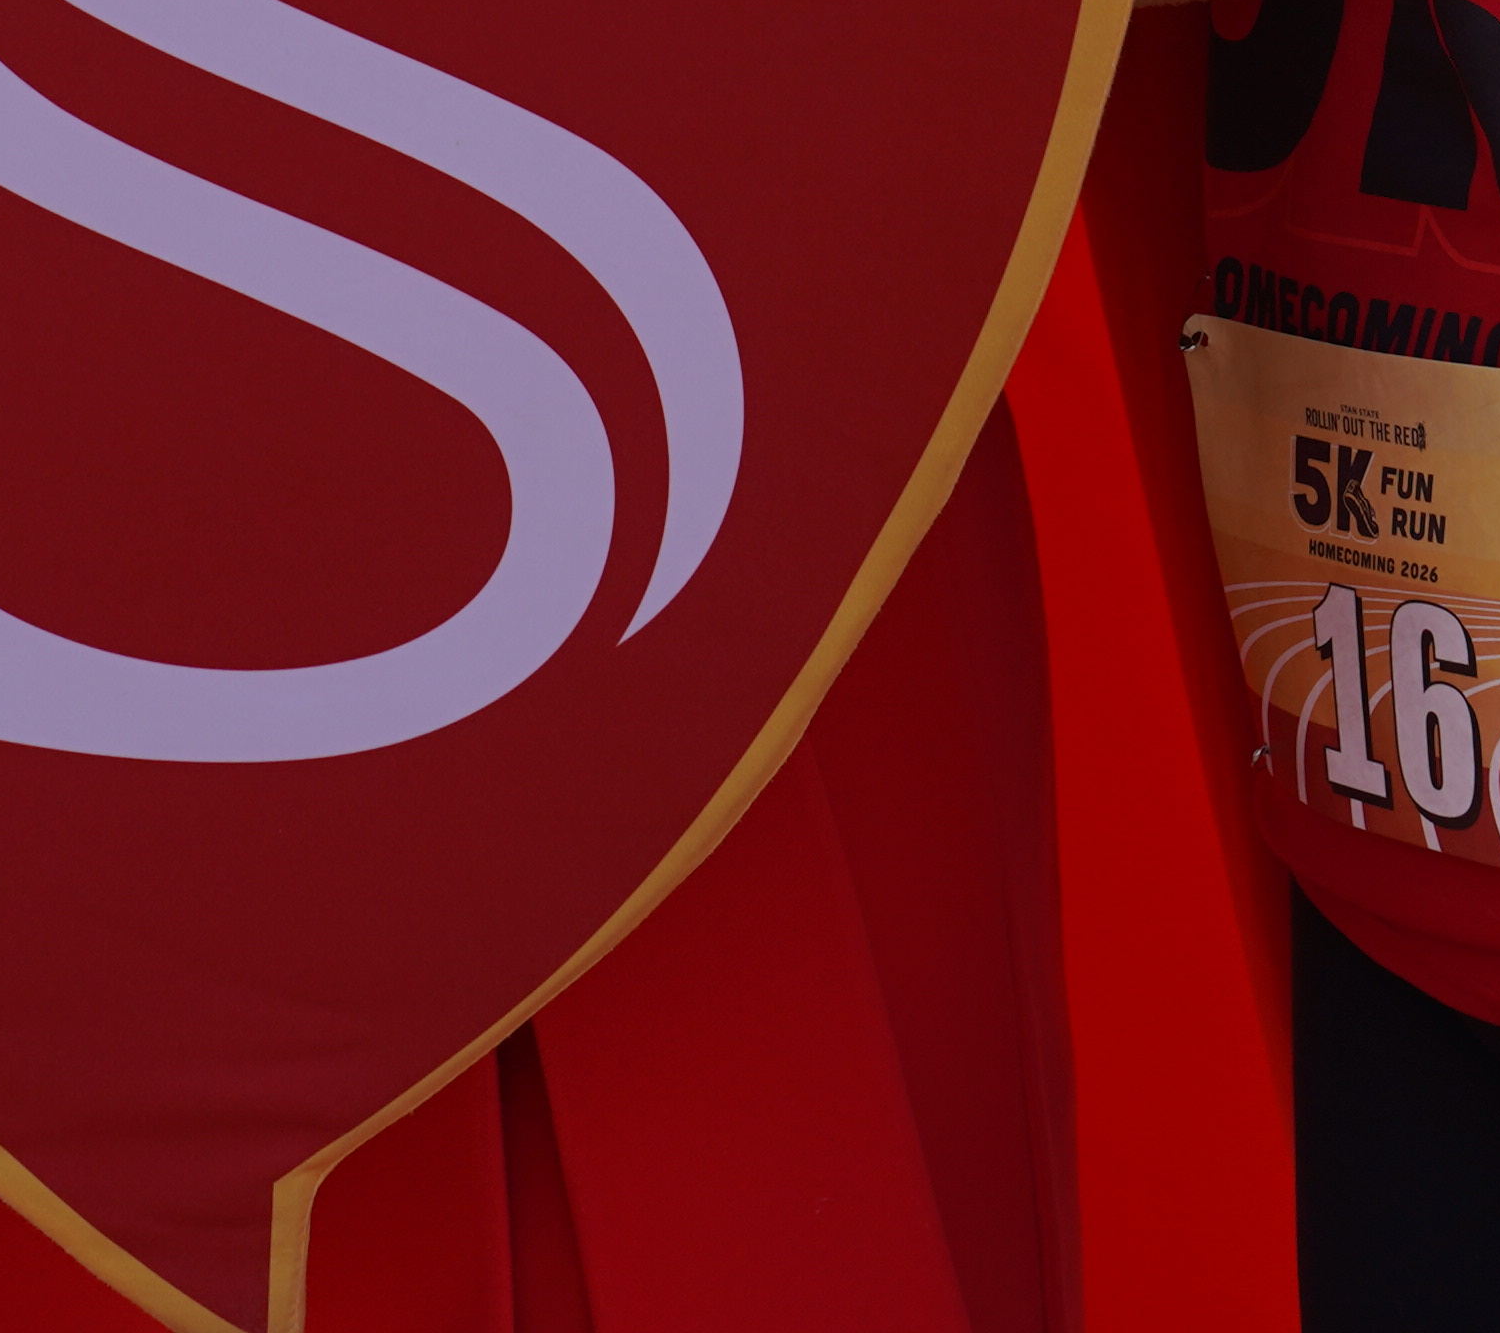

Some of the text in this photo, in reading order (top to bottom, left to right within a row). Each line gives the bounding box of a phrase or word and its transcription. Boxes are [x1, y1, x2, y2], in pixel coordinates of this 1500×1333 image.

[1340, 404, 1380, 420] STAN STATE
[1342, 416, 1365, 437] OUT
[1369, 421, 1391, 443] THE
[1394, 425, 1419, 448] RED
[1293, 434, 1379, 539] 5K
[1381, 466, 1434, 503] FUN
[1391, 507, 1446, 544] RUN
[1308, 539, 1438, 583] HOMECOMING 2026
[1312, 582, 1483, 830] 16
